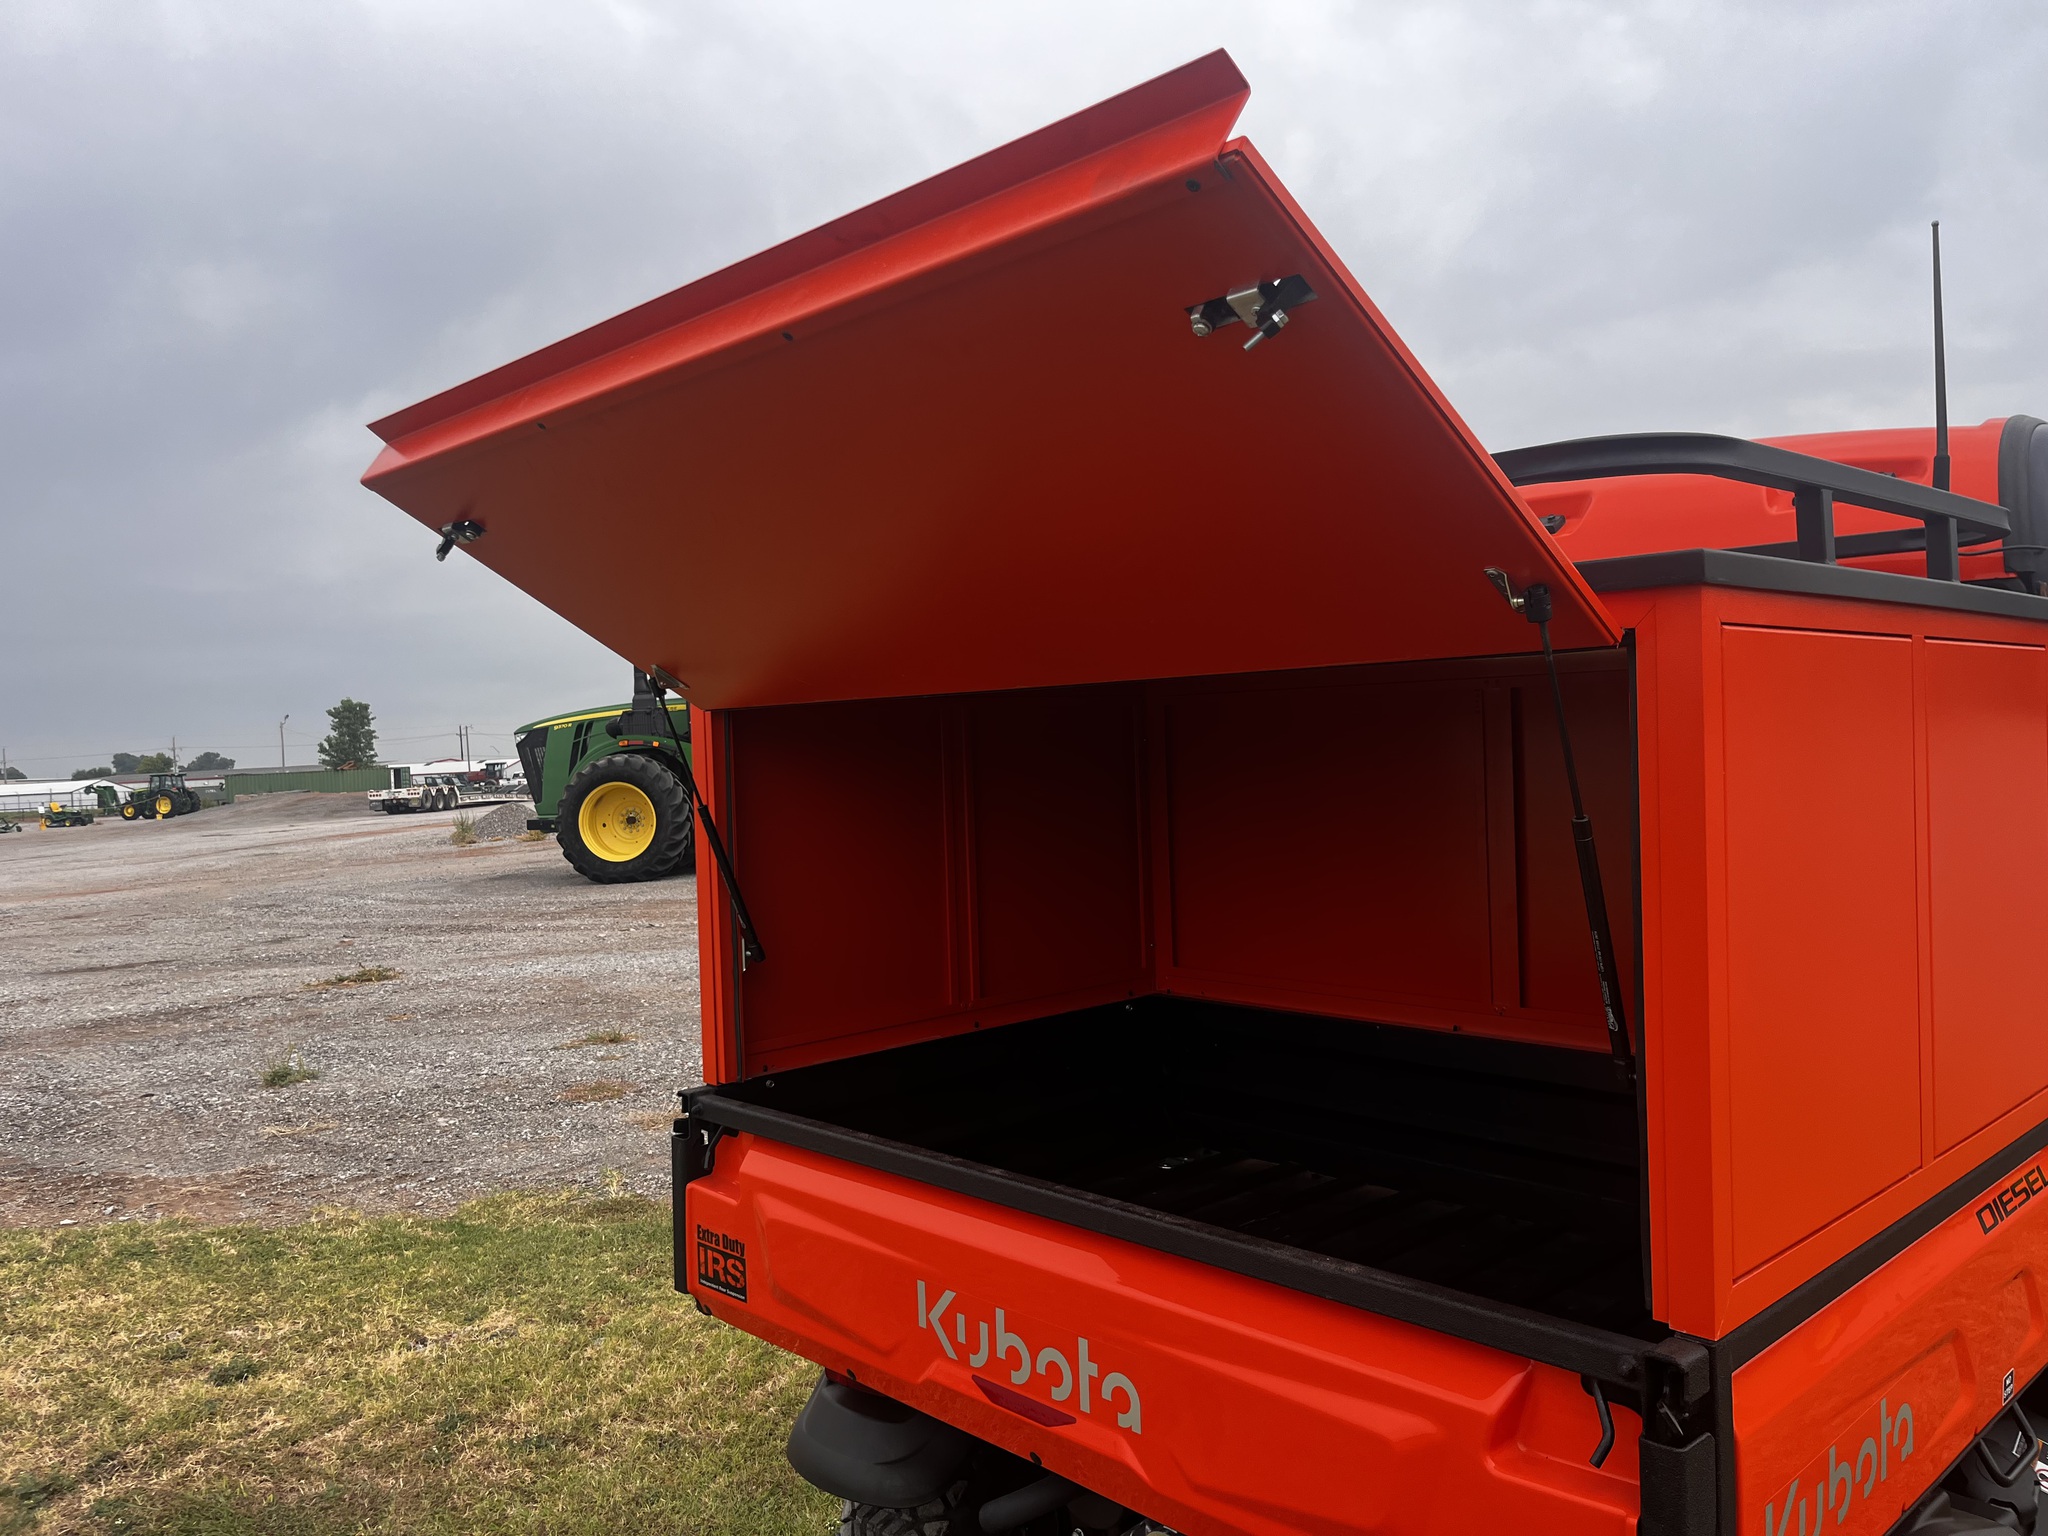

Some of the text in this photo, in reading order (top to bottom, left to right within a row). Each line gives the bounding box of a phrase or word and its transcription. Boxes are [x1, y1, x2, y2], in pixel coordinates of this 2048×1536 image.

[1976, 1165, 2048, 1235] DIESEL
[697, 1224, 745, 1258] Extra Duty
[700, 1246, 745, 1289] IRS
[917, 1279, 1142, 1435] Kubota
